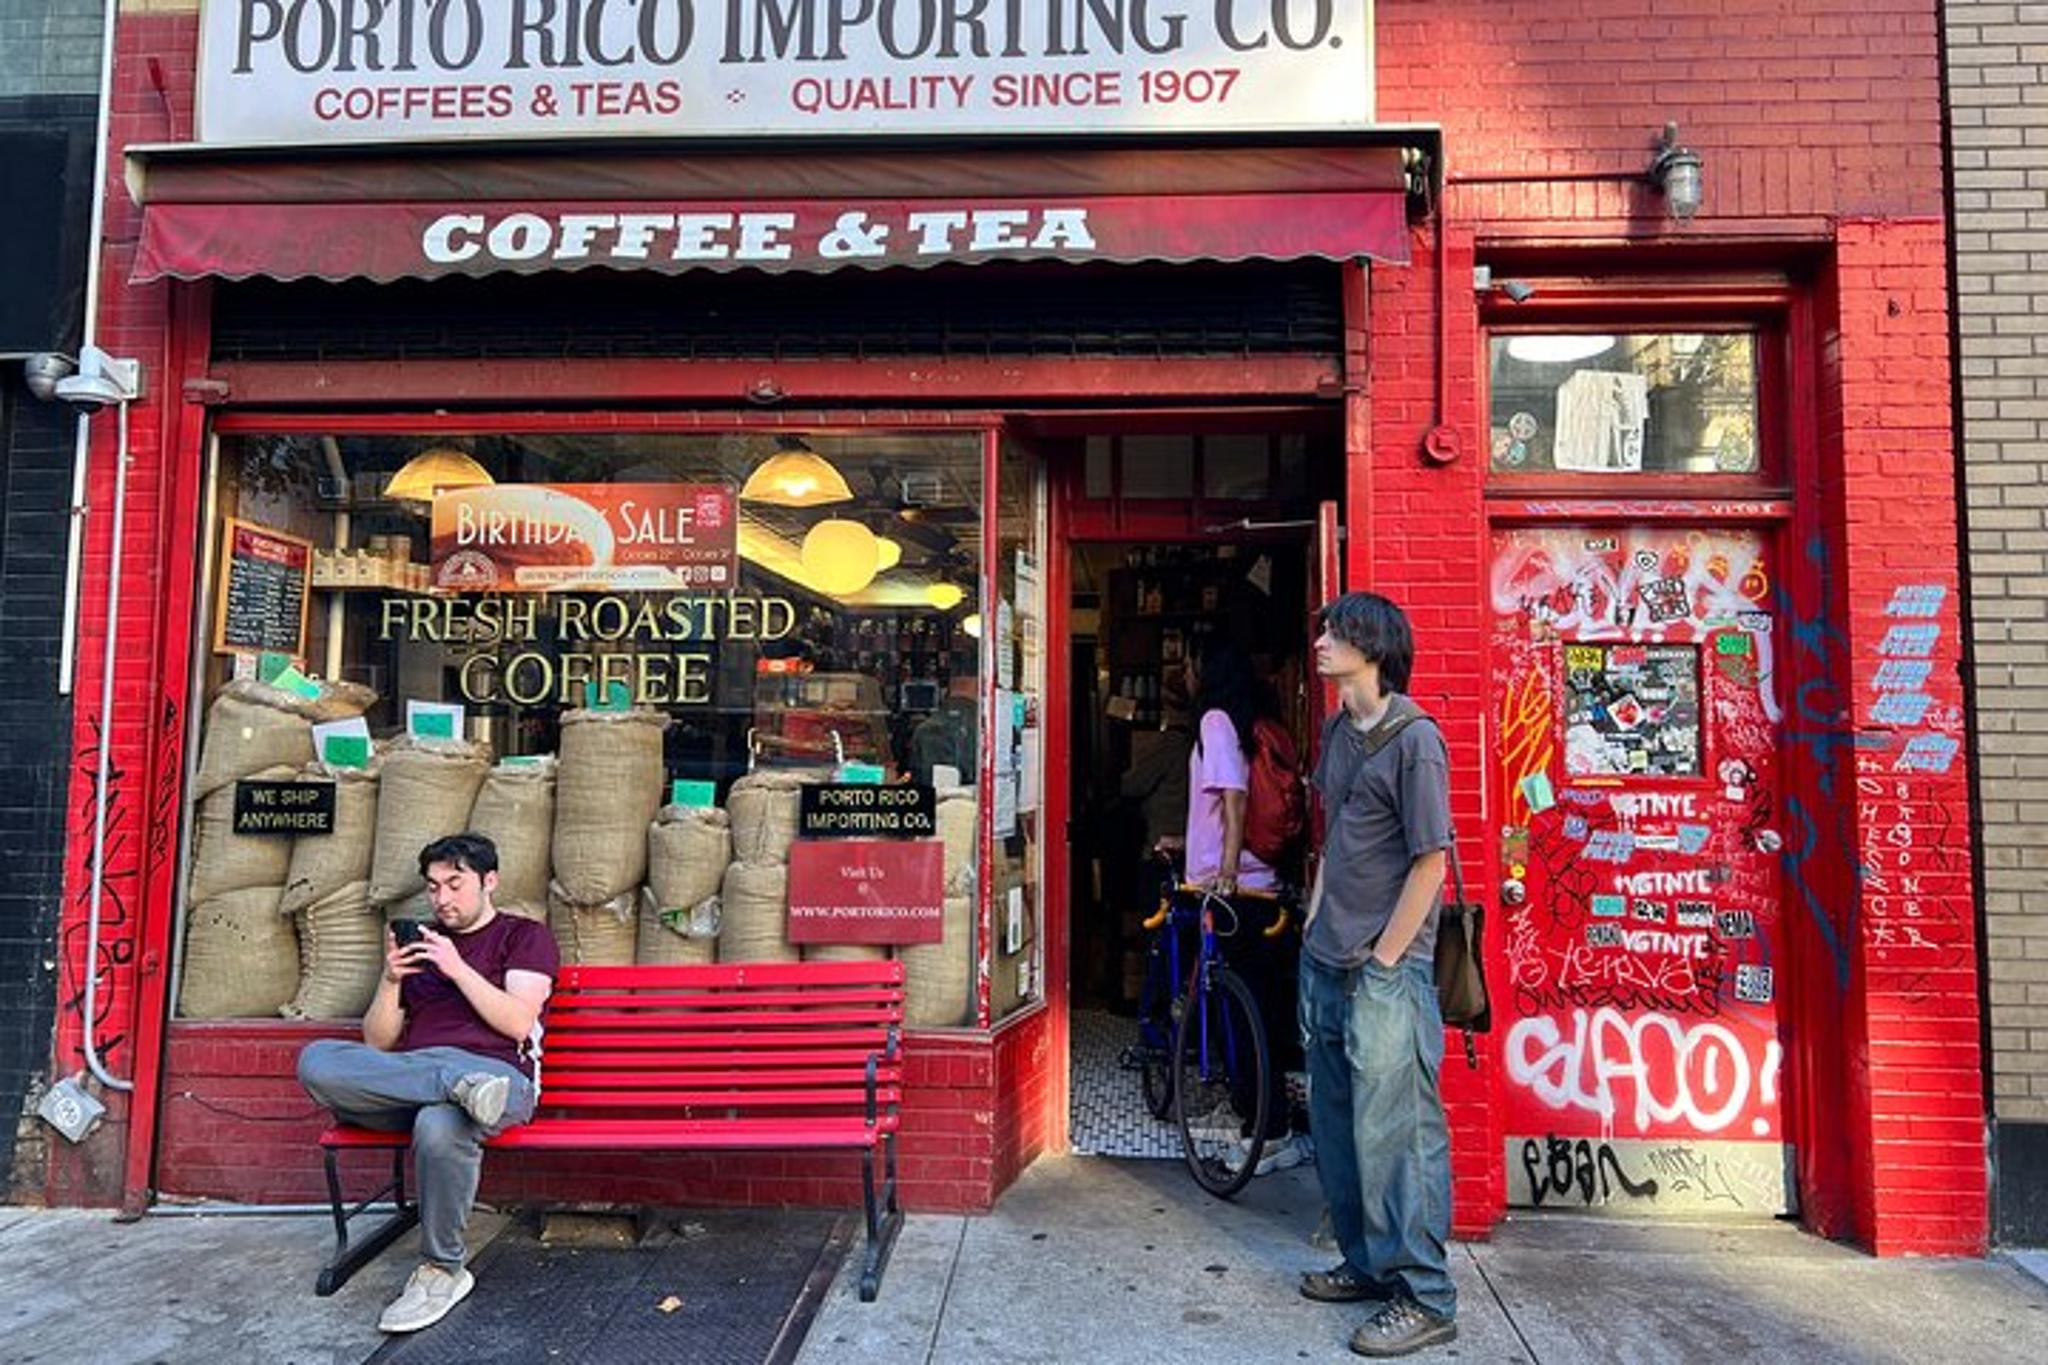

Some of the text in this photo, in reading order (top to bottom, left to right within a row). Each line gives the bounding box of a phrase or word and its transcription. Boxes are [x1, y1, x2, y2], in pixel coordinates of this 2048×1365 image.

[231, 0, 484, 74] PORTO
[503, 0, 696, 70] RICO
[719, 0, 1188, 64] IMPORTING
[314, 80, 682, 122] COFFEES & TEAS
[792, 68, 1241, 115] QUALITY SINCE 1907
[422, 208, 1097, 263] COFFEE & TEA
[378, 595, 798, 641] FRESH ROASTED
[459, 650, 712, 705] COFFEE
[252, 788, 319, 805] WE SHIP
[819, 788, 920, 806] PORTO RICO
[239, 811, 328, 829] ANYWHERE
[807, 812, 931, 829] IMPORTING CO.
